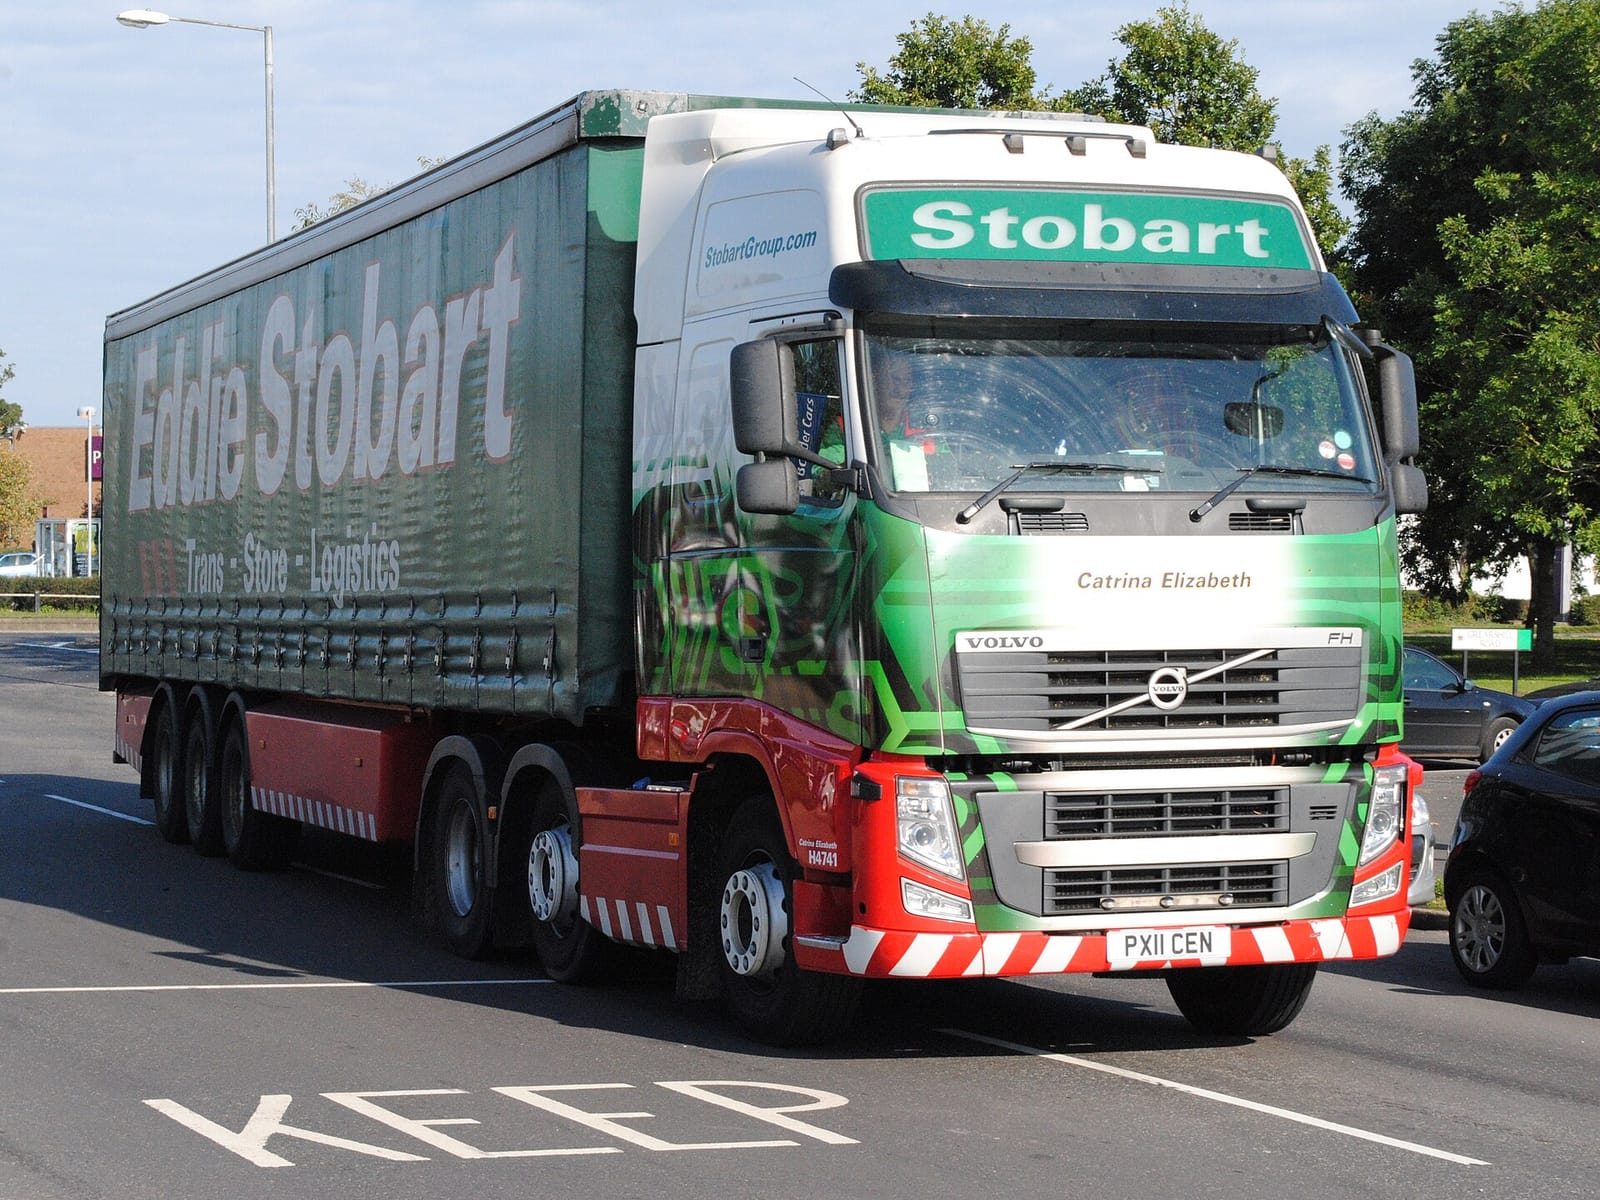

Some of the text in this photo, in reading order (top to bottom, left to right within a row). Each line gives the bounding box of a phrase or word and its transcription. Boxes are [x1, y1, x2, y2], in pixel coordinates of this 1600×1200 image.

[911, 200, 1270, 259] Stobart
[704, 231, 817, 268] StobartGroup.com
[128, 232, 521, 512] Eddie Stobart
[802, 397, 814, 428] Cars
[797, 430, 811, 477] Boder
[186, 538, 224, 594] Trans
[243, 532, 288, 593] Store
[310, 522, 400, 609] Logistics
[1077, 571, 1252, 589] Catrina Elizabeth
[965, 636, 1044, 648] VOLVO
[1327, 632, 1354, 645] FH
[1151, 685, 1185, 693] VOLVO
[808, 850, 838, 867] H4741
[1125, 932, 1213, 956] PX11 CEN
[142, 1081, 862, 1168] KEEP
